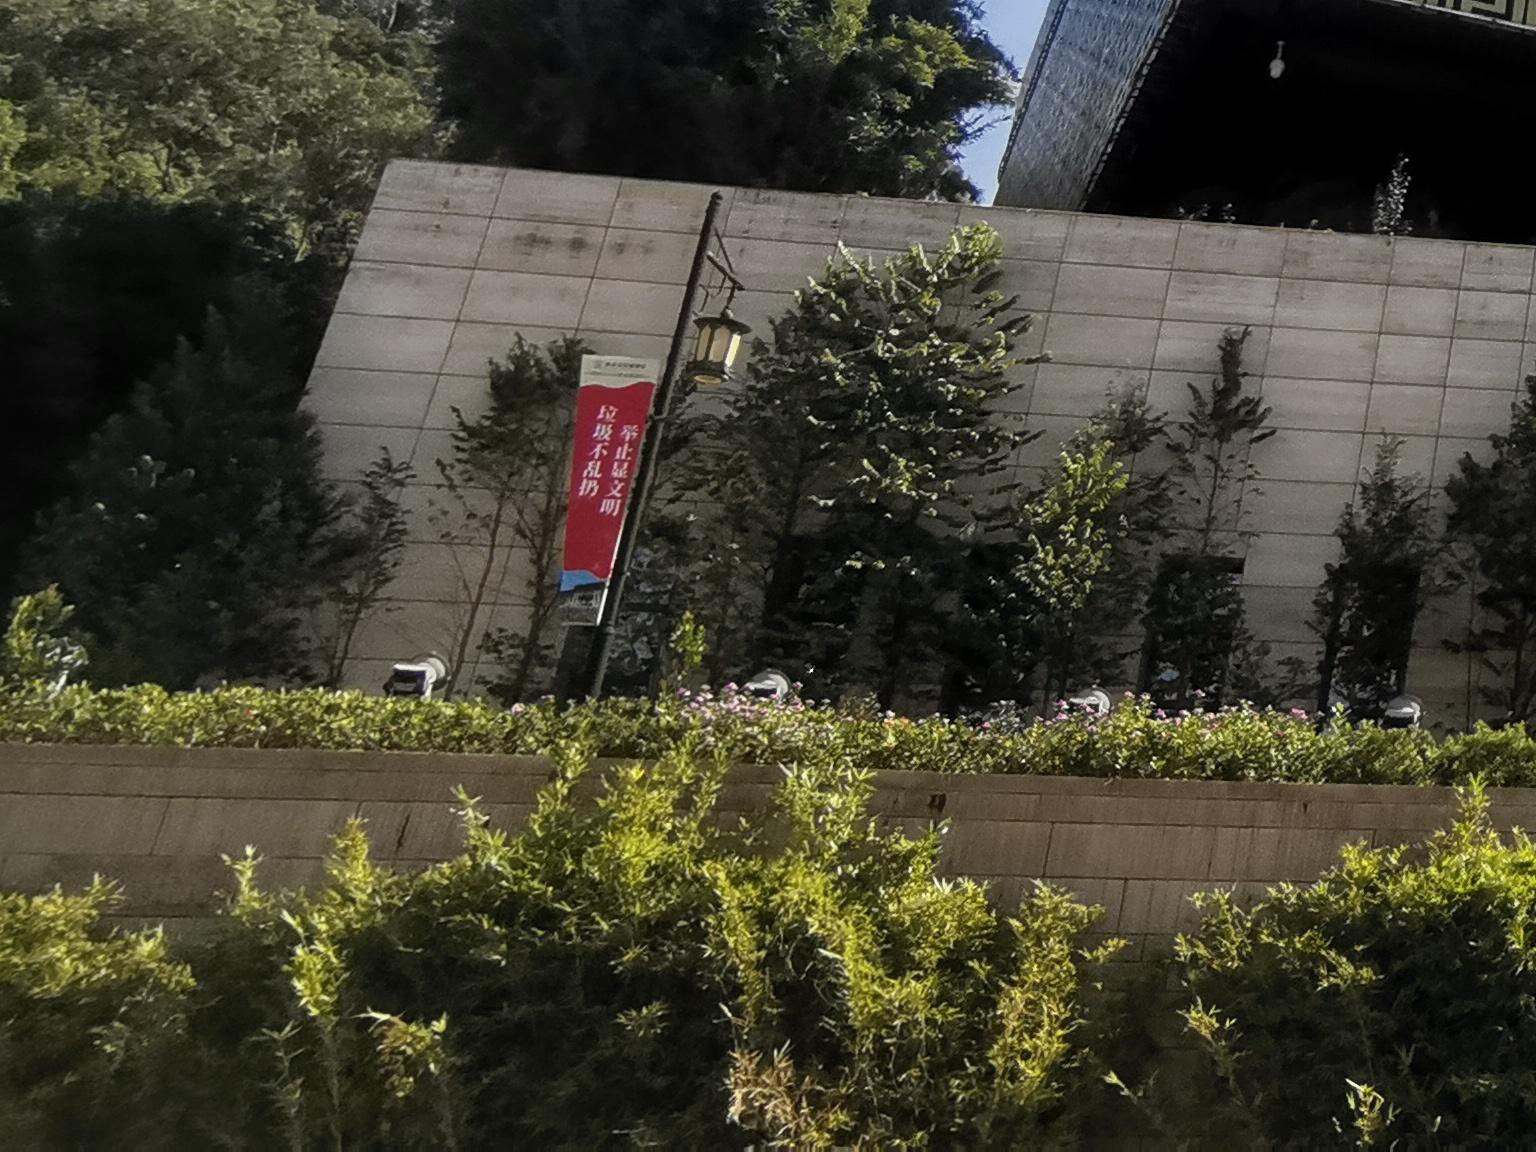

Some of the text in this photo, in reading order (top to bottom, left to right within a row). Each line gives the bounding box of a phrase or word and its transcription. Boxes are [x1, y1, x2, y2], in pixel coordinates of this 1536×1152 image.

[578, 404, 619, 497] 垃圾不乱扔
[600, 424, 640, 516] 举止显文明
